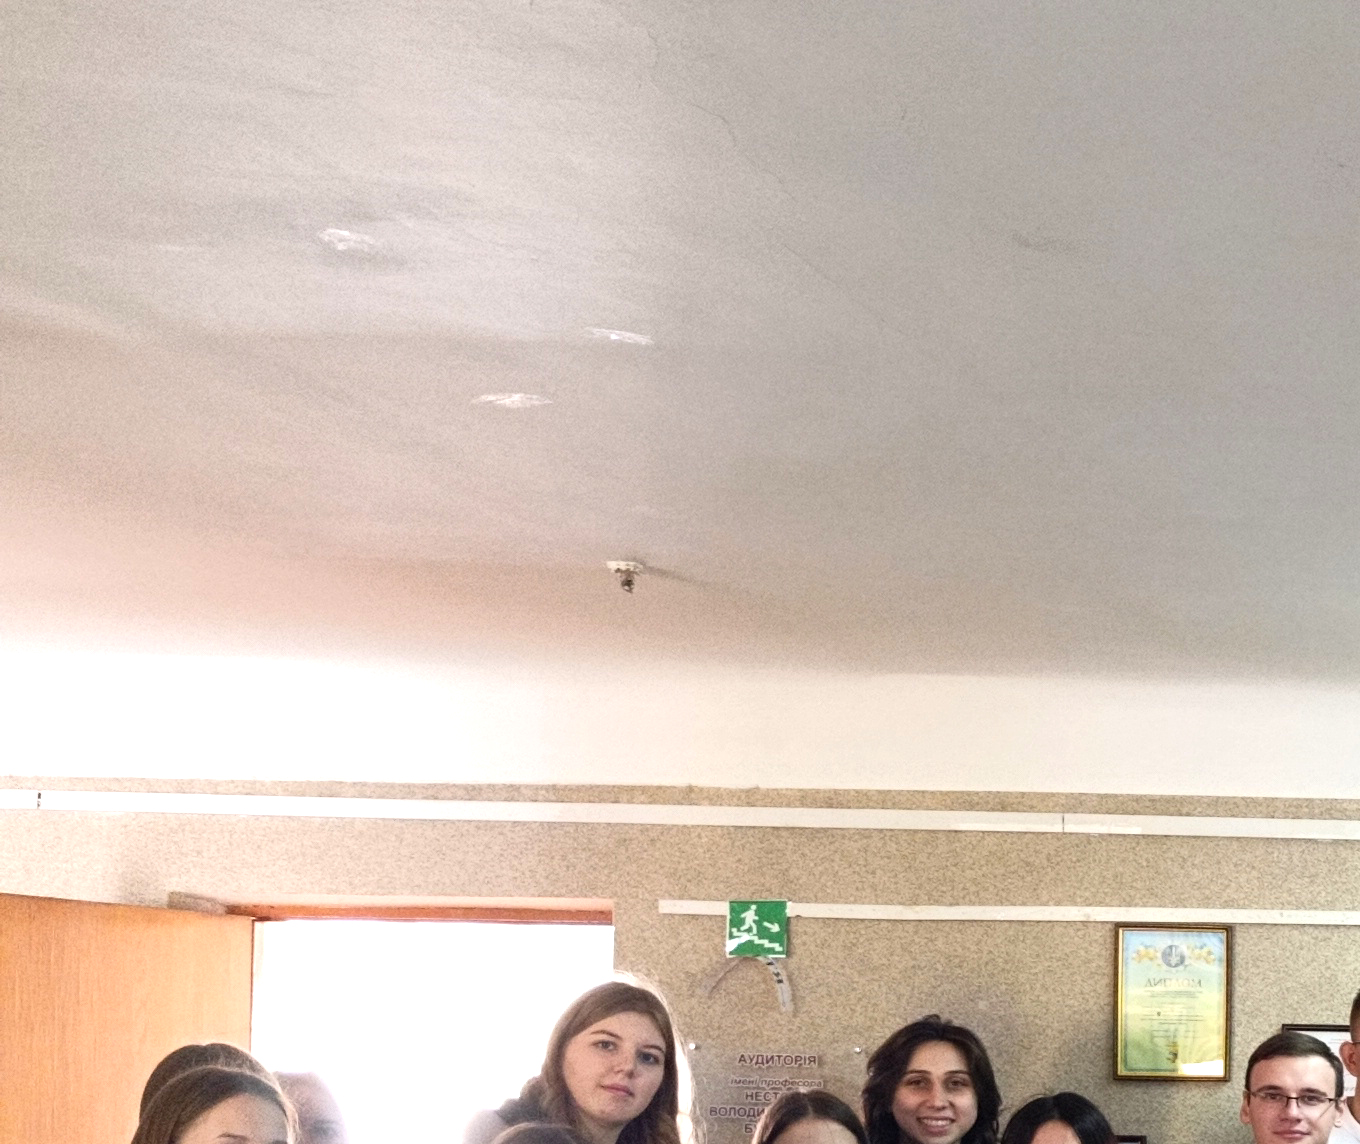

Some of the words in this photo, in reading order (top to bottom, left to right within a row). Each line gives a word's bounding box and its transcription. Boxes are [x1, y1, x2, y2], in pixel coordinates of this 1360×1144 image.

[737, 1054, 817, 1066] АУДИТОРІЯ
[730, 1077, 759, 1087] імені
[761, 1078, 823, 1088] професора
